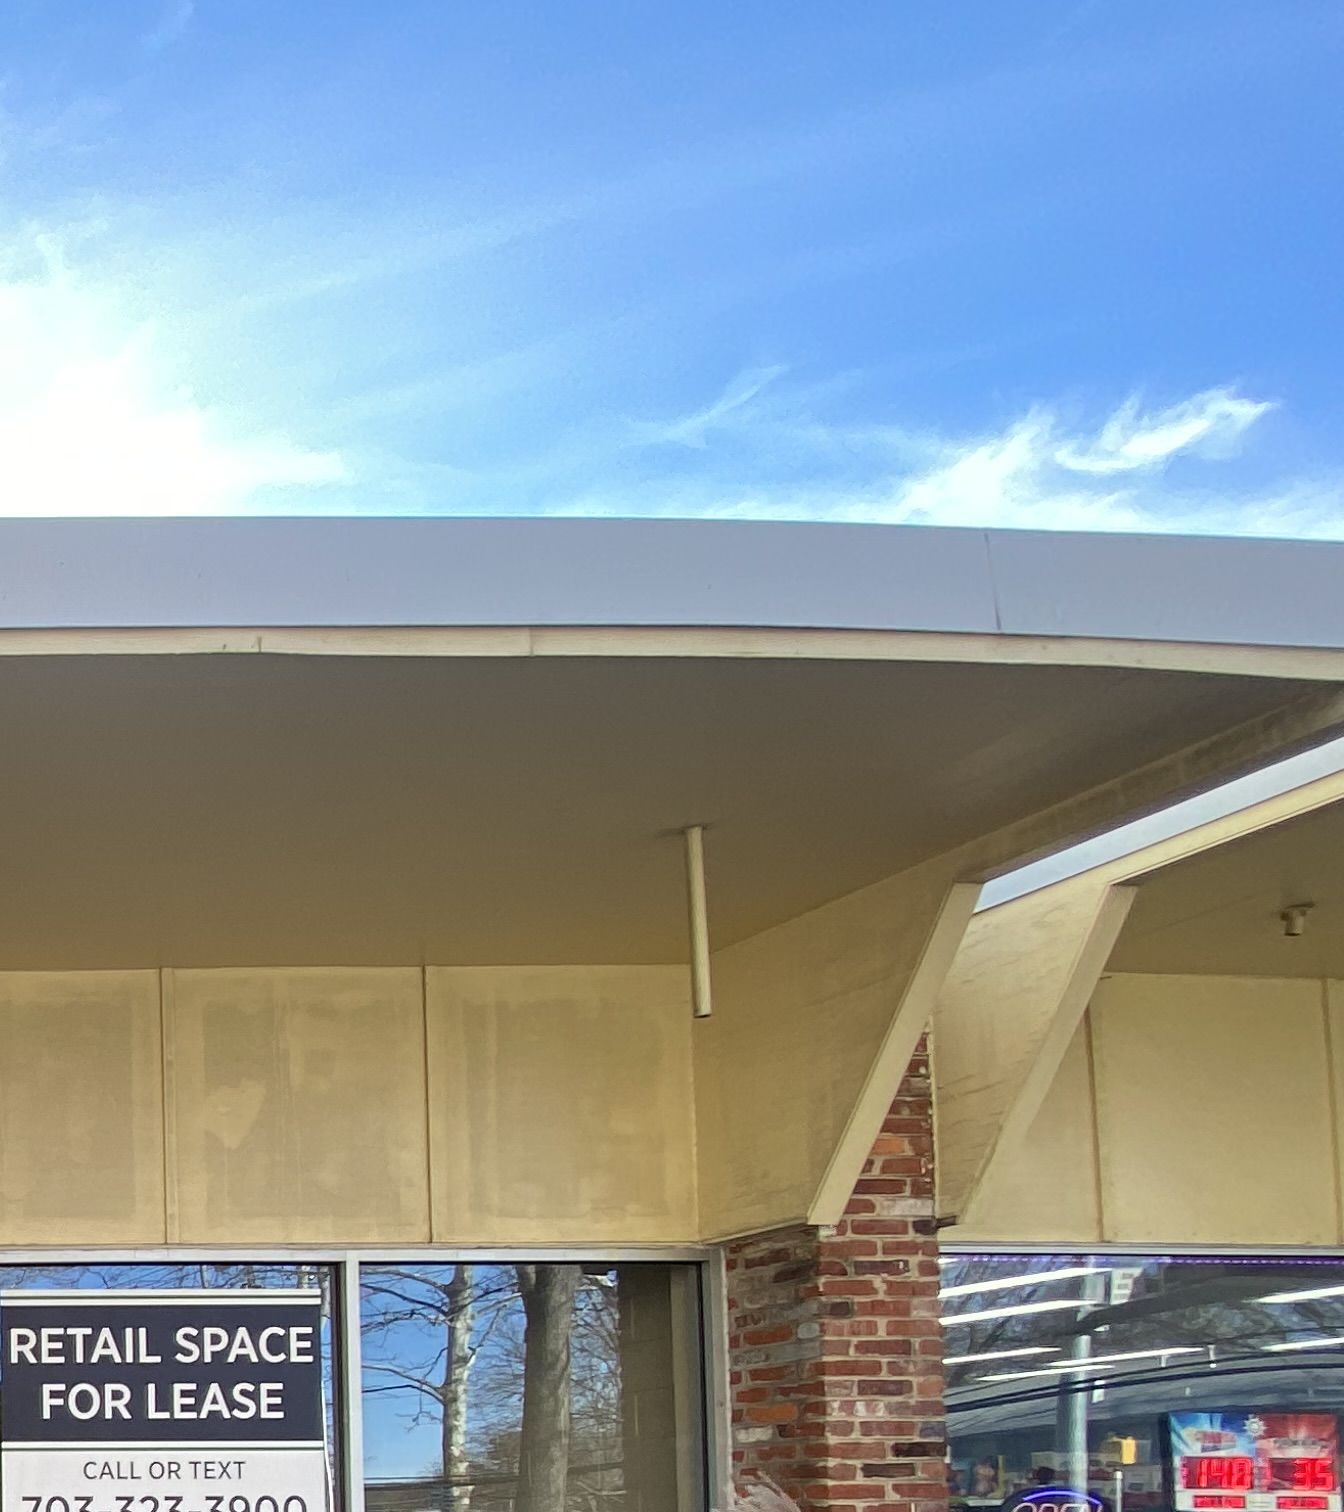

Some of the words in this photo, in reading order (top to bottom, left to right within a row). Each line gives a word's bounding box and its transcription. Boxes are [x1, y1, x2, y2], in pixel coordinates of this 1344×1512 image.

[9, 1326, 162, 1365] RETAIL
[174, 1325, 314, 1364] SPACE
[41, 1382, 132, 1421] FOR
[147, 1382, 286, 1420] LEASE
[82, 1460, 142, 1480] CALL
[148, 1460, 182, 1480] OR
[188, 1460, 247, 1480] TEXT
